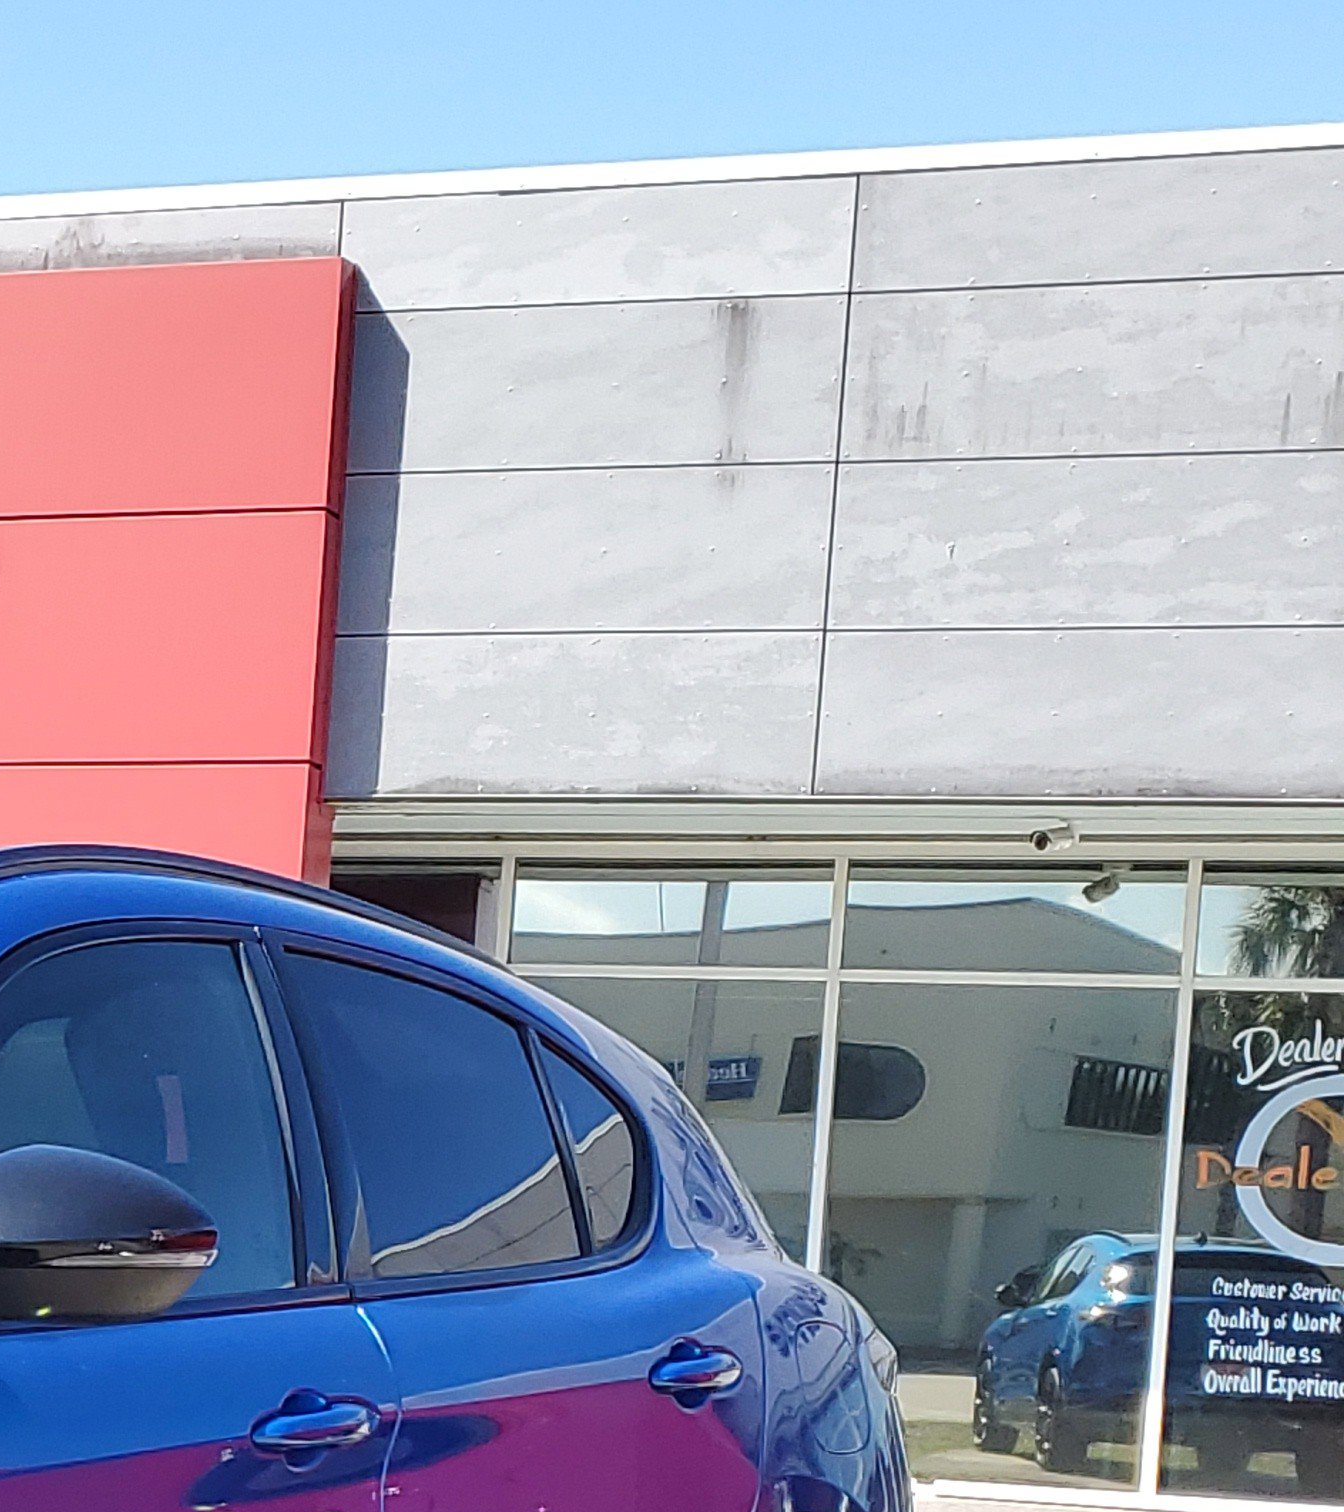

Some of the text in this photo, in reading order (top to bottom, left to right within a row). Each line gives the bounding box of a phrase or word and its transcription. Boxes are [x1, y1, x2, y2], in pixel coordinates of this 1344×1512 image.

[1212, 1276, 1288, 1301] Customer
[1206, 1306, 1342, 1336] Quality of Work
[1208, 1338, 1323, 1365] Friendliness
[1203, 1366, 1262, 1394] Overall
